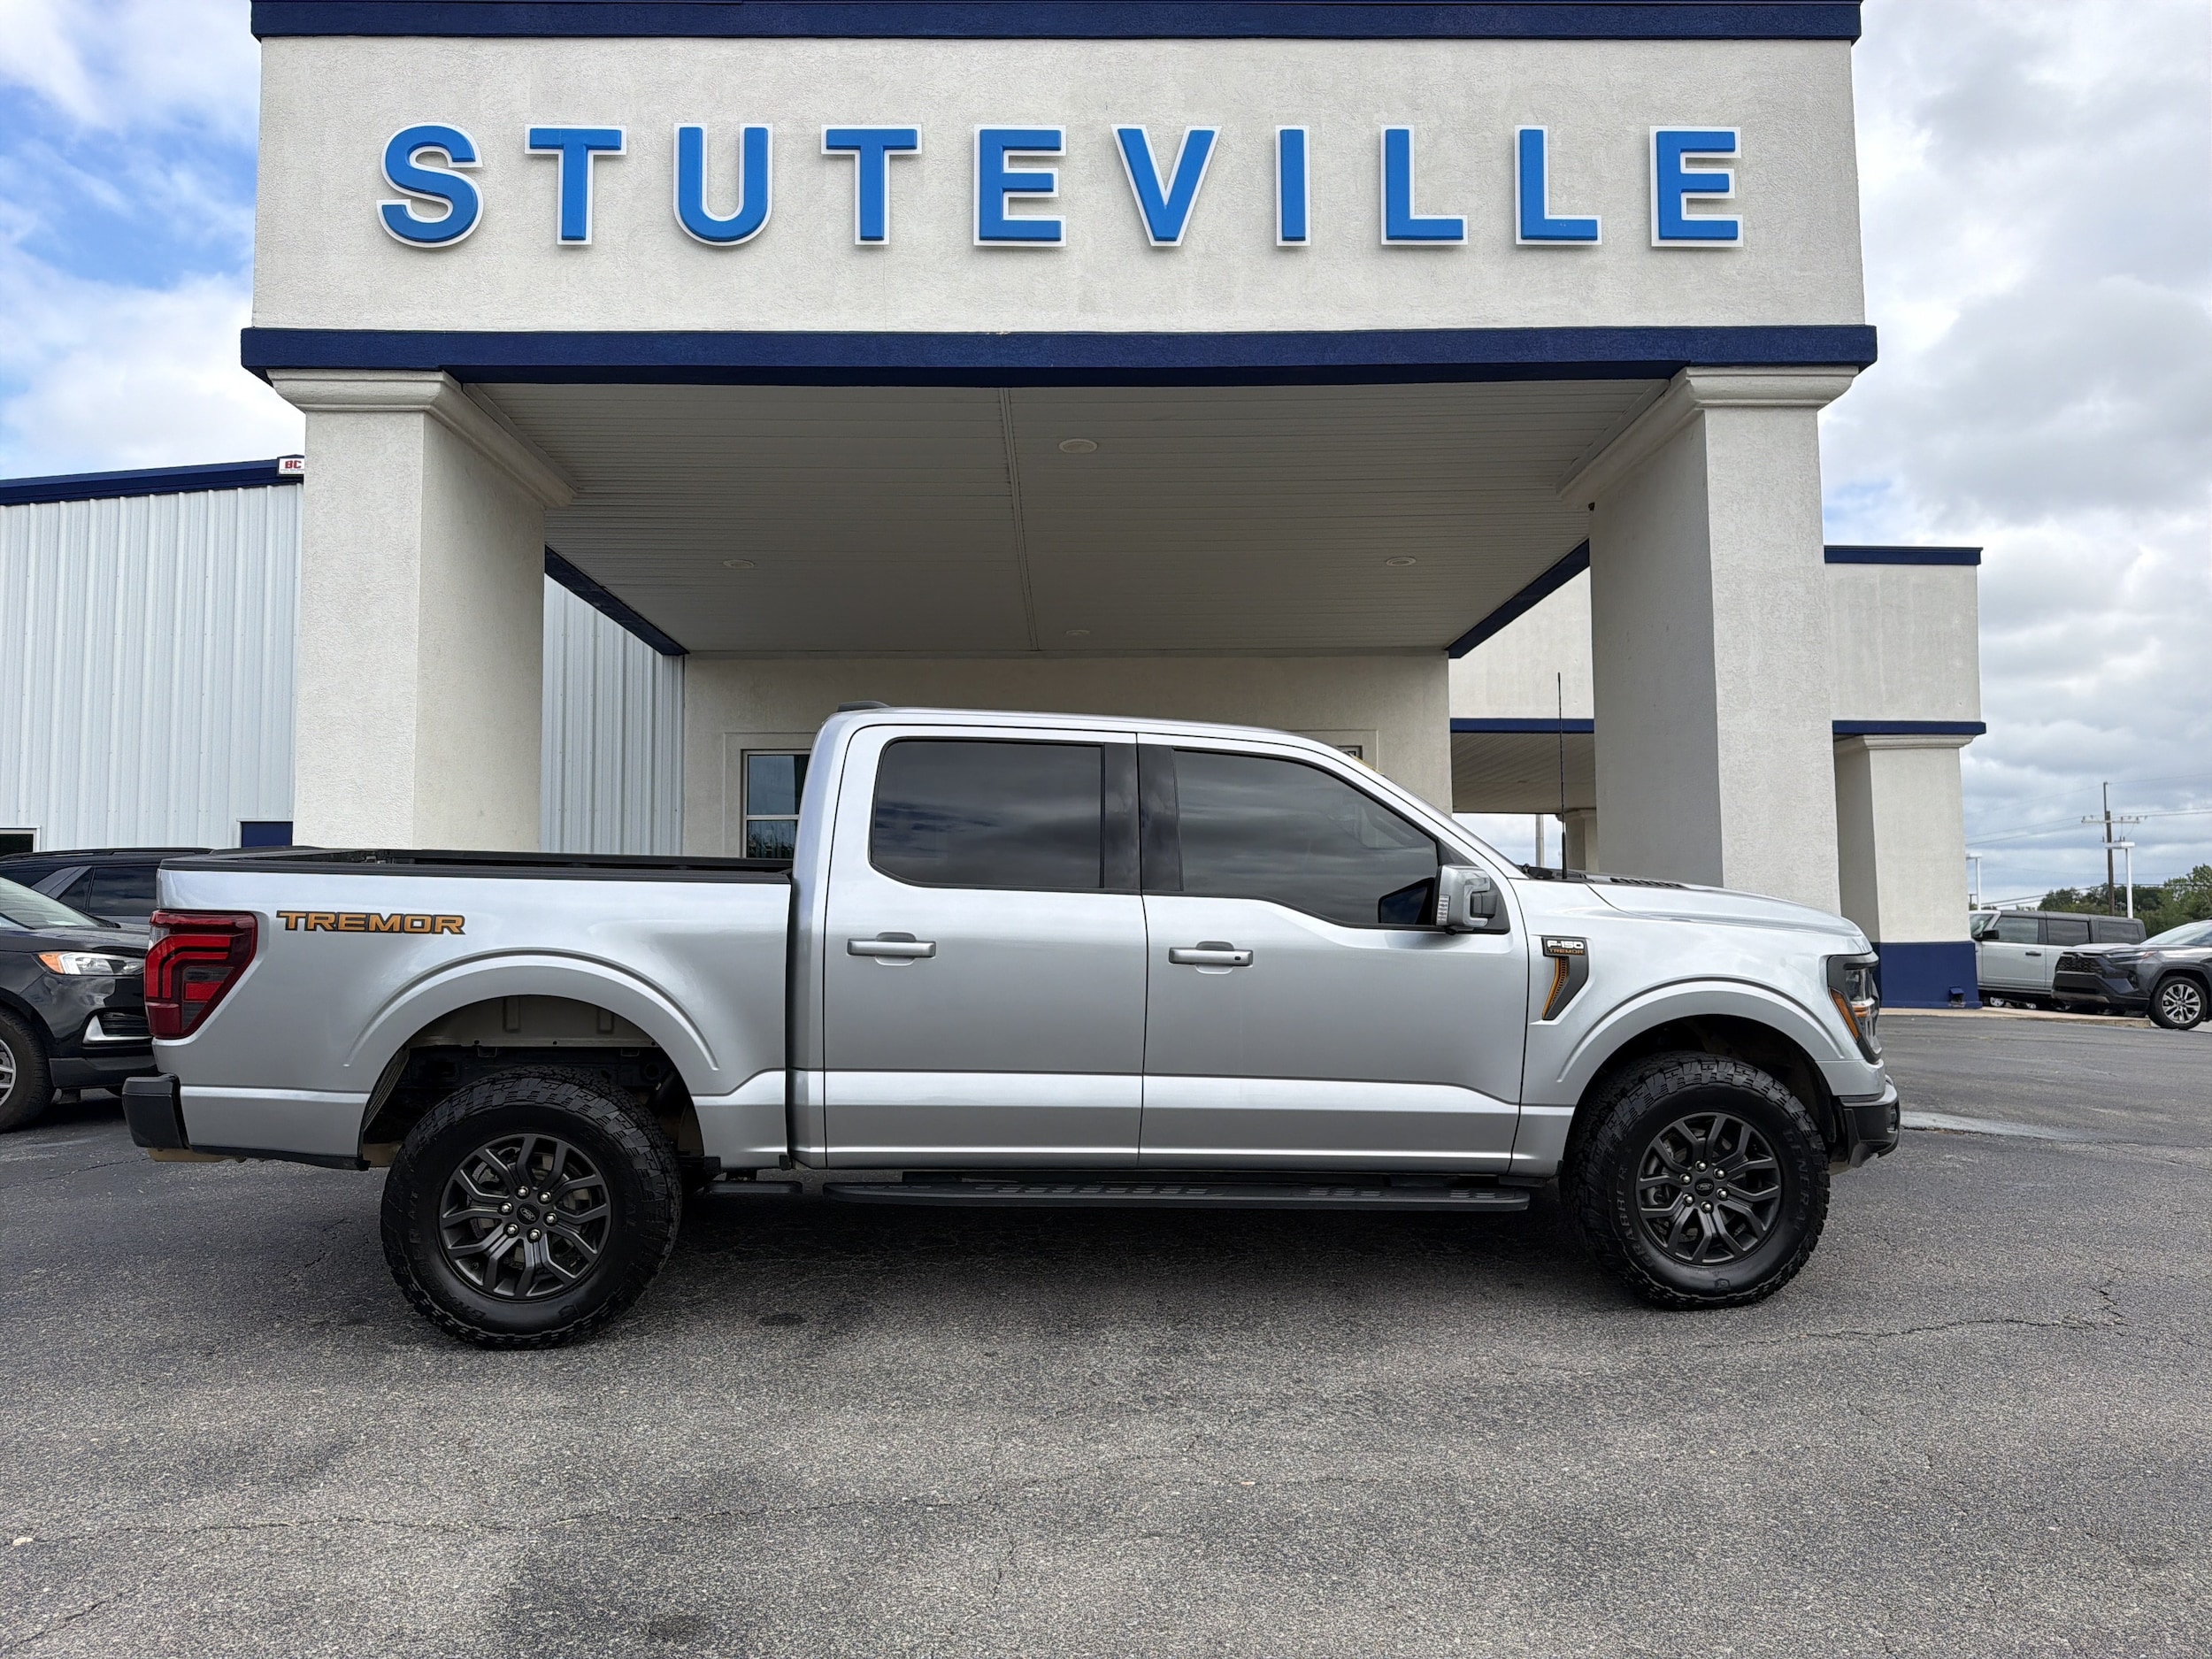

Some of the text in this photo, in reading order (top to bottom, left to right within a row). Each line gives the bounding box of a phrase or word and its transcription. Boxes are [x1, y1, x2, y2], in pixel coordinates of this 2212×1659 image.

[377, 122, 1743, 249] STUTEVILLE
[285, 460, 303, 469] BC
[276, 910, 465, 935] TREMOR
[1547, 940, 1585, 949] F-150
